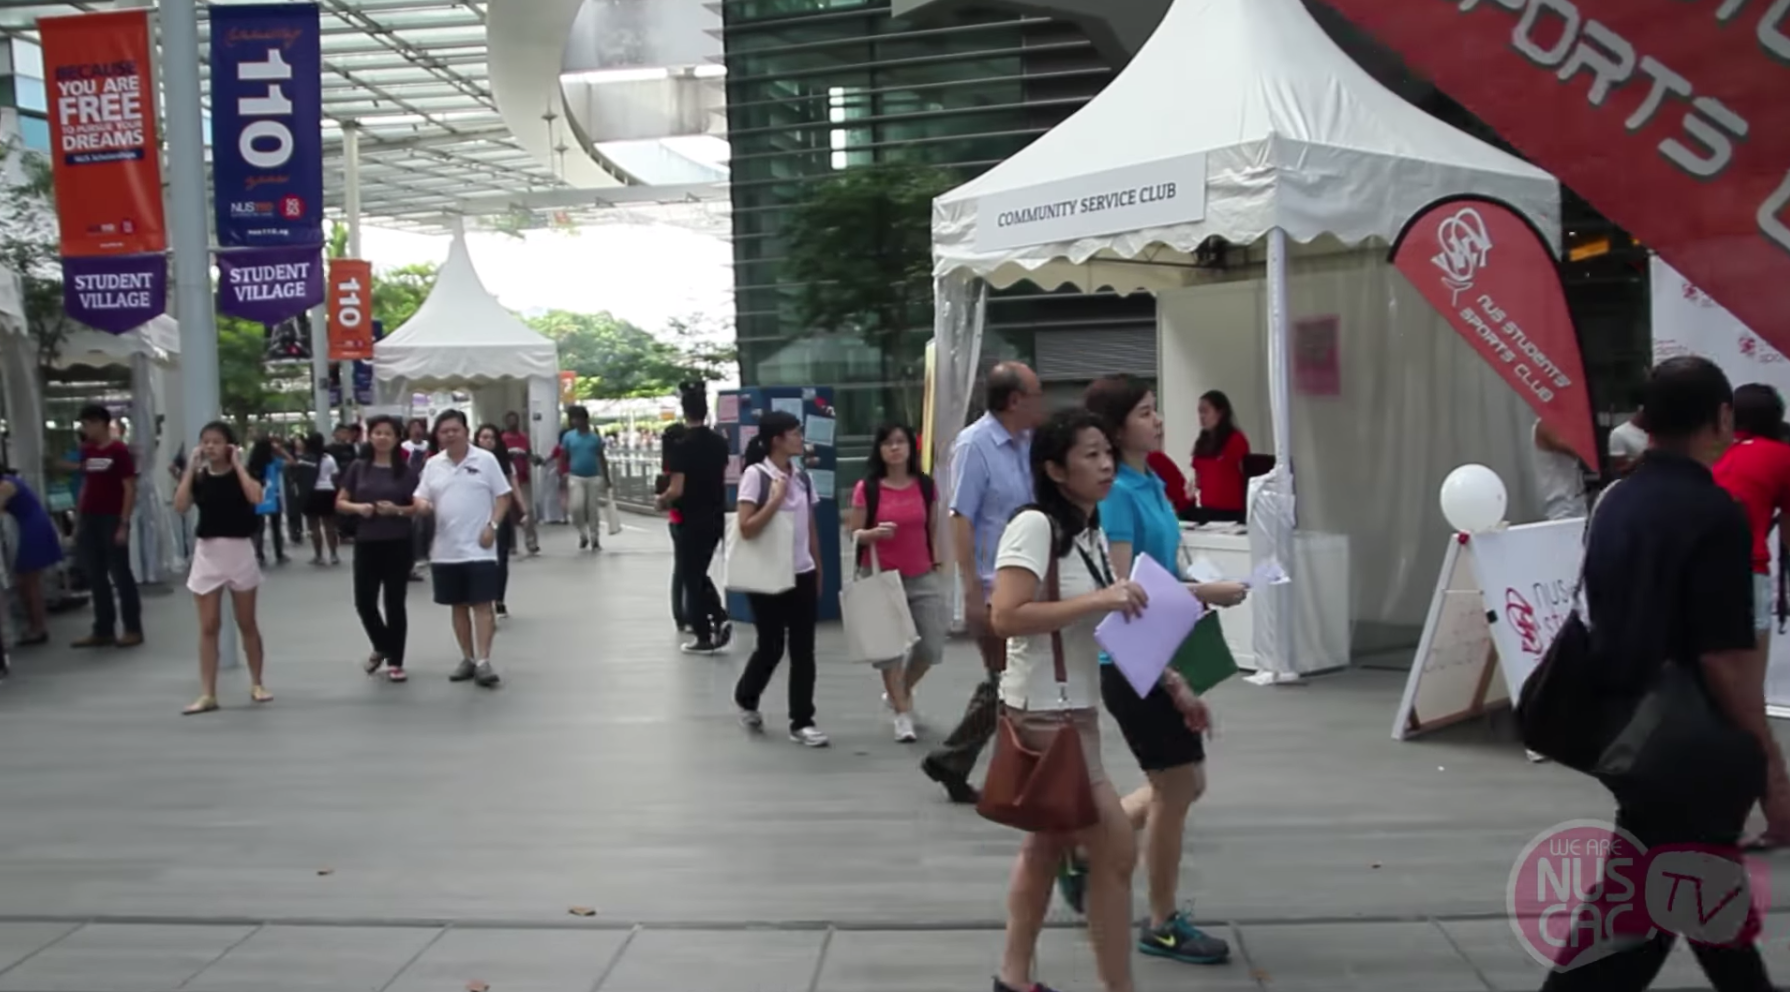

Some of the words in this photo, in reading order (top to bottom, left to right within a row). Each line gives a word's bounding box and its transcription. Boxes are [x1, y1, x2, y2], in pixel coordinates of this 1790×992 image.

[57, 78, 97, 96] YOU
[103, 75, 140, 92] ARE
[1459, 0, 1749, 176] ORTS
[58, 91, 143, 126] FREE
[237, 48, 294, 168] 110
[62, 129, 144, 151] DREAMS
[997, 199, 1078, 228] COMMUNITY
[1080, 186, 1137, 214] SERVICE
[1139, 182, 1177, 204] CLUB
[74, 272, 154, 290] STUDENT
[229, 262, 310, 284] STUDENT
[79, 291, 151, 309] VILLAGE
[233, 281, 306, 302] VILLAGE
[338, 277, 361, 328] 110
[1476, 294, 1507, 323] NUS
[1459, 307, 1516, 363] SPORTS
[1513, 363, 1555, 402] CLUB
